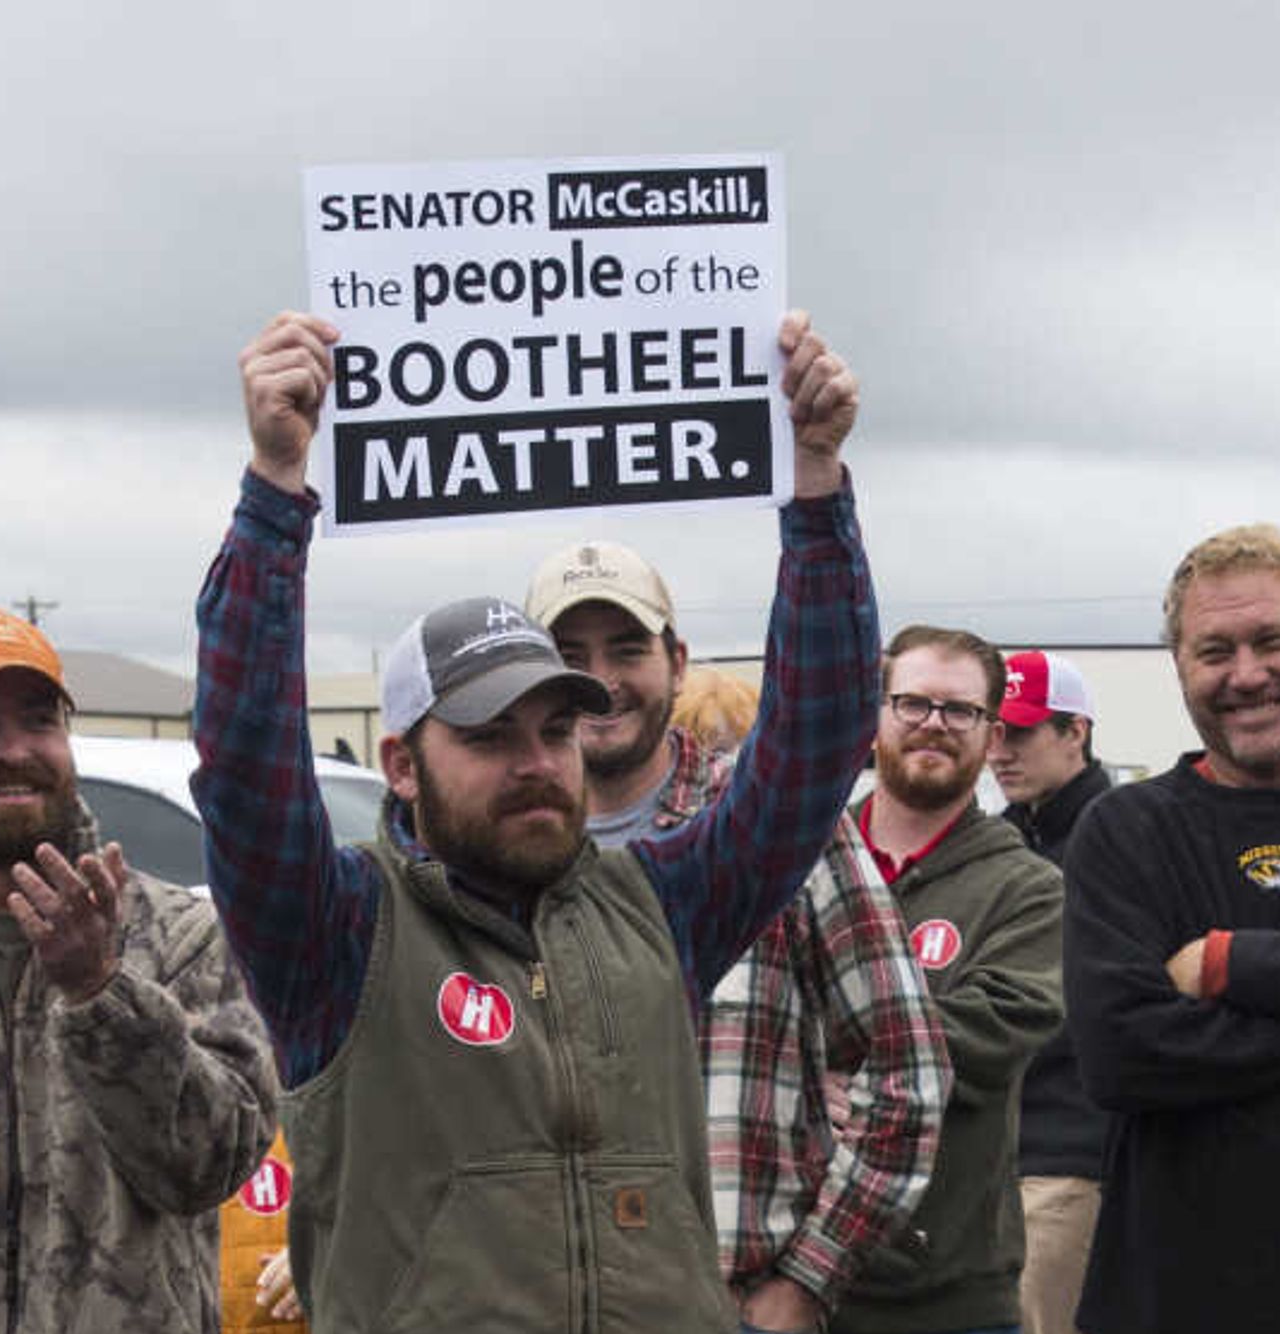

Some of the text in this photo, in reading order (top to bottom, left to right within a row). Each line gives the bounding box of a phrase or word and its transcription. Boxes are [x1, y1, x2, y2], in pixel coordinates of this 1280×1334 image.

[320, 175, 763, 232] SENATOR McCaskill,
[330, 238, 761, 323] the people of the
[333, 326, 769, 410] BOOTHEEL
[361, 419, 751, 502] MATTER.
[921, 926, 946, 961] H
[460, 986, 493, 1034] H
[251, 1163, 278, 1206] H
